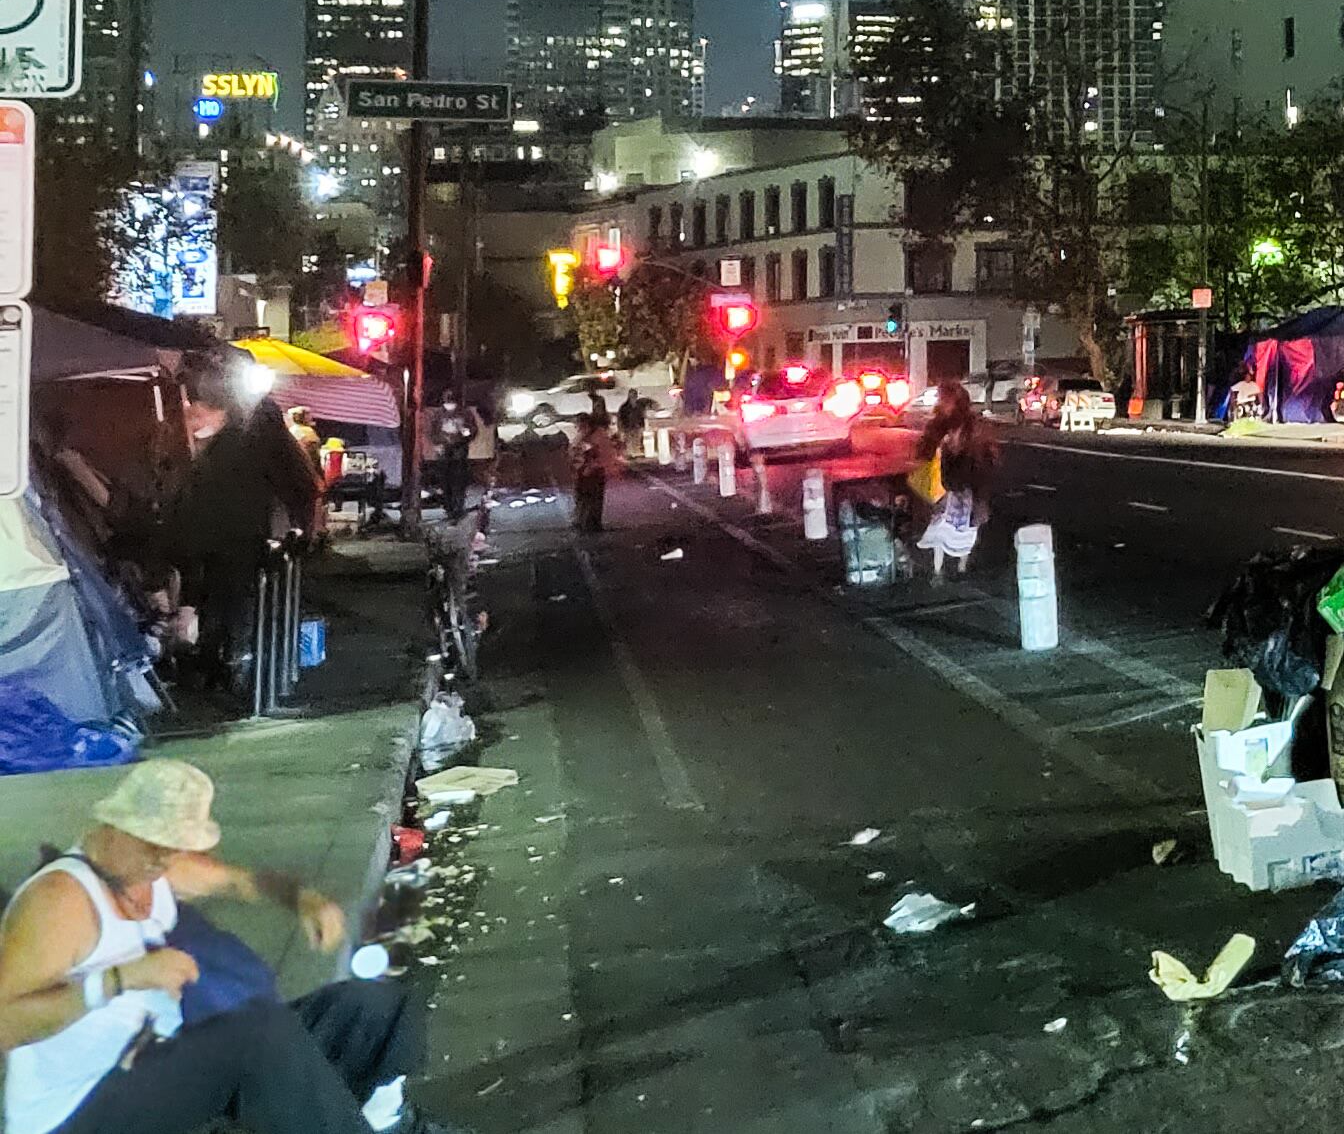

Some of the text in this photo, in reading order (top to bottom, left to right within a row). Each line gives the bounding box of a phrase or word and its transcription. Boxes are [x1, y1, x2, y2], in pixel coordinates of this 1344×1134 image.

[202, 73, 274, 97] SSLYN
[358, 90, 500, 111] San Pedro St
[929, 324, 976, 337] Market
